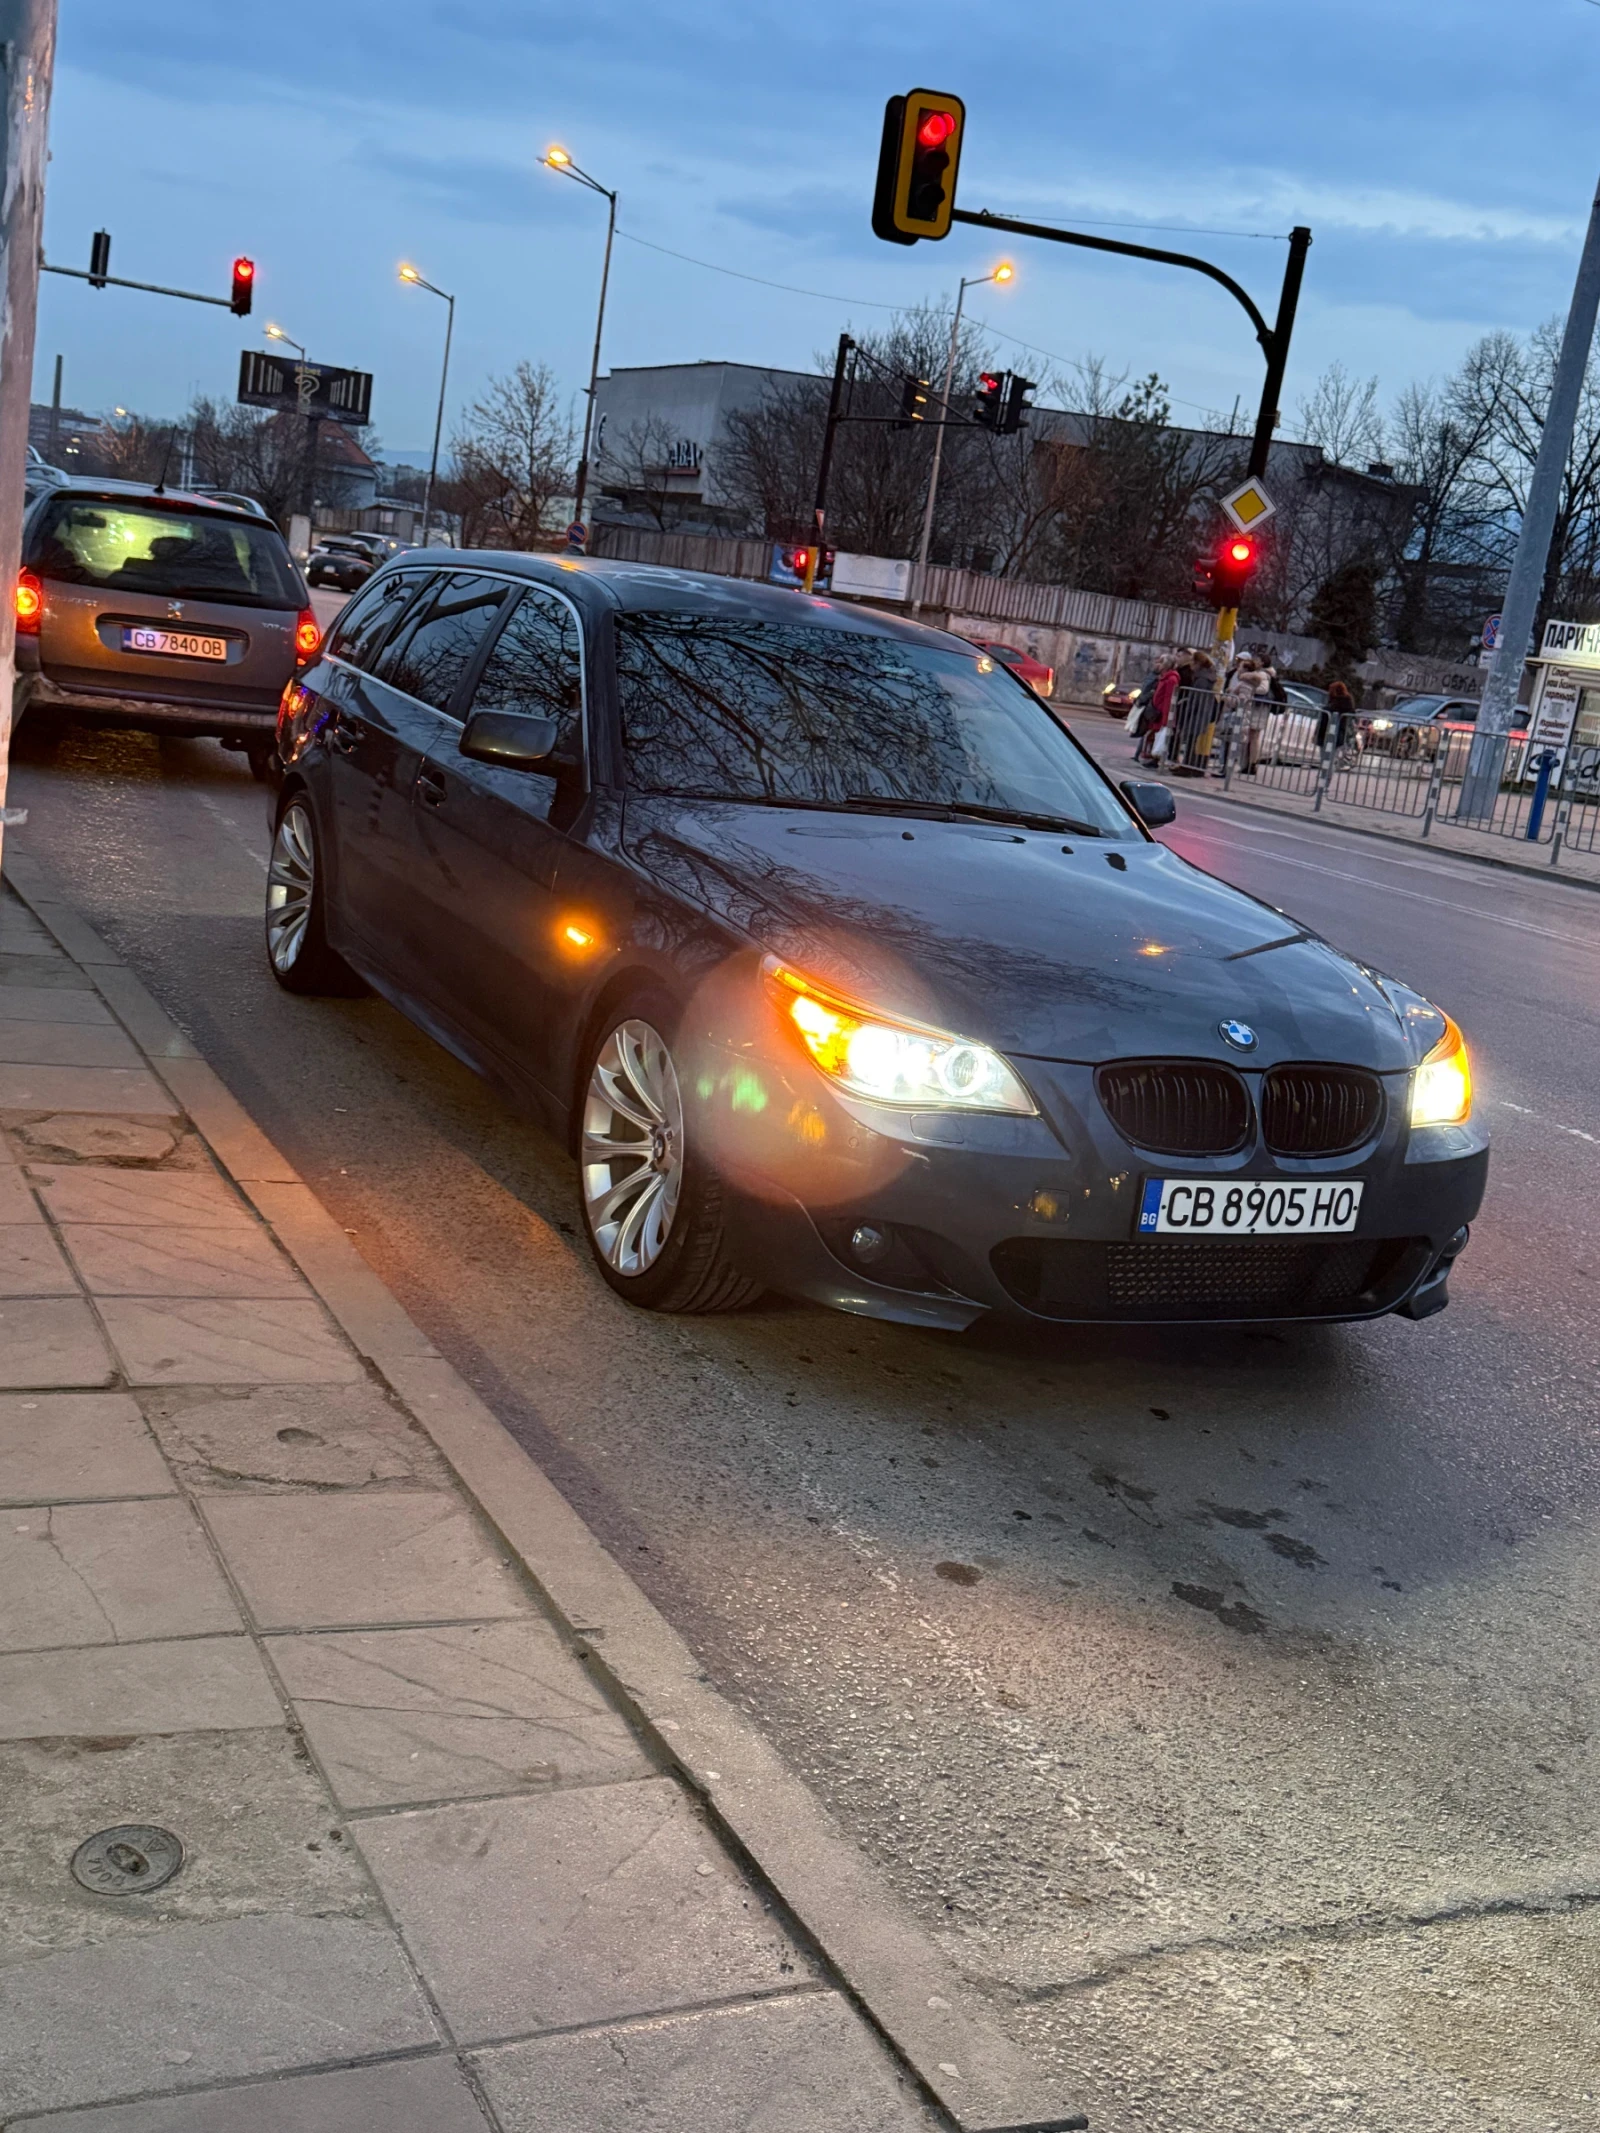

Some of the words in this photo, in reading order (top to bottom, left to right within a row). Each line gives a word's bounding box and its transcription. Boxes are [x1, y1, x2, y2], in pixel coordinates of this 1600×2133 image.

[134, 631, 157, 649] CB
[159, 633, 199, 655] 7840
[202, 642, 223, 656] OB
[1141, 1212, 1157, 1226] BG
[1166, 1186, 1215, 1227] CB
[1221, 1187, 1307, 1227] 8905
[1310, 1187, 1354, 1227] HO
